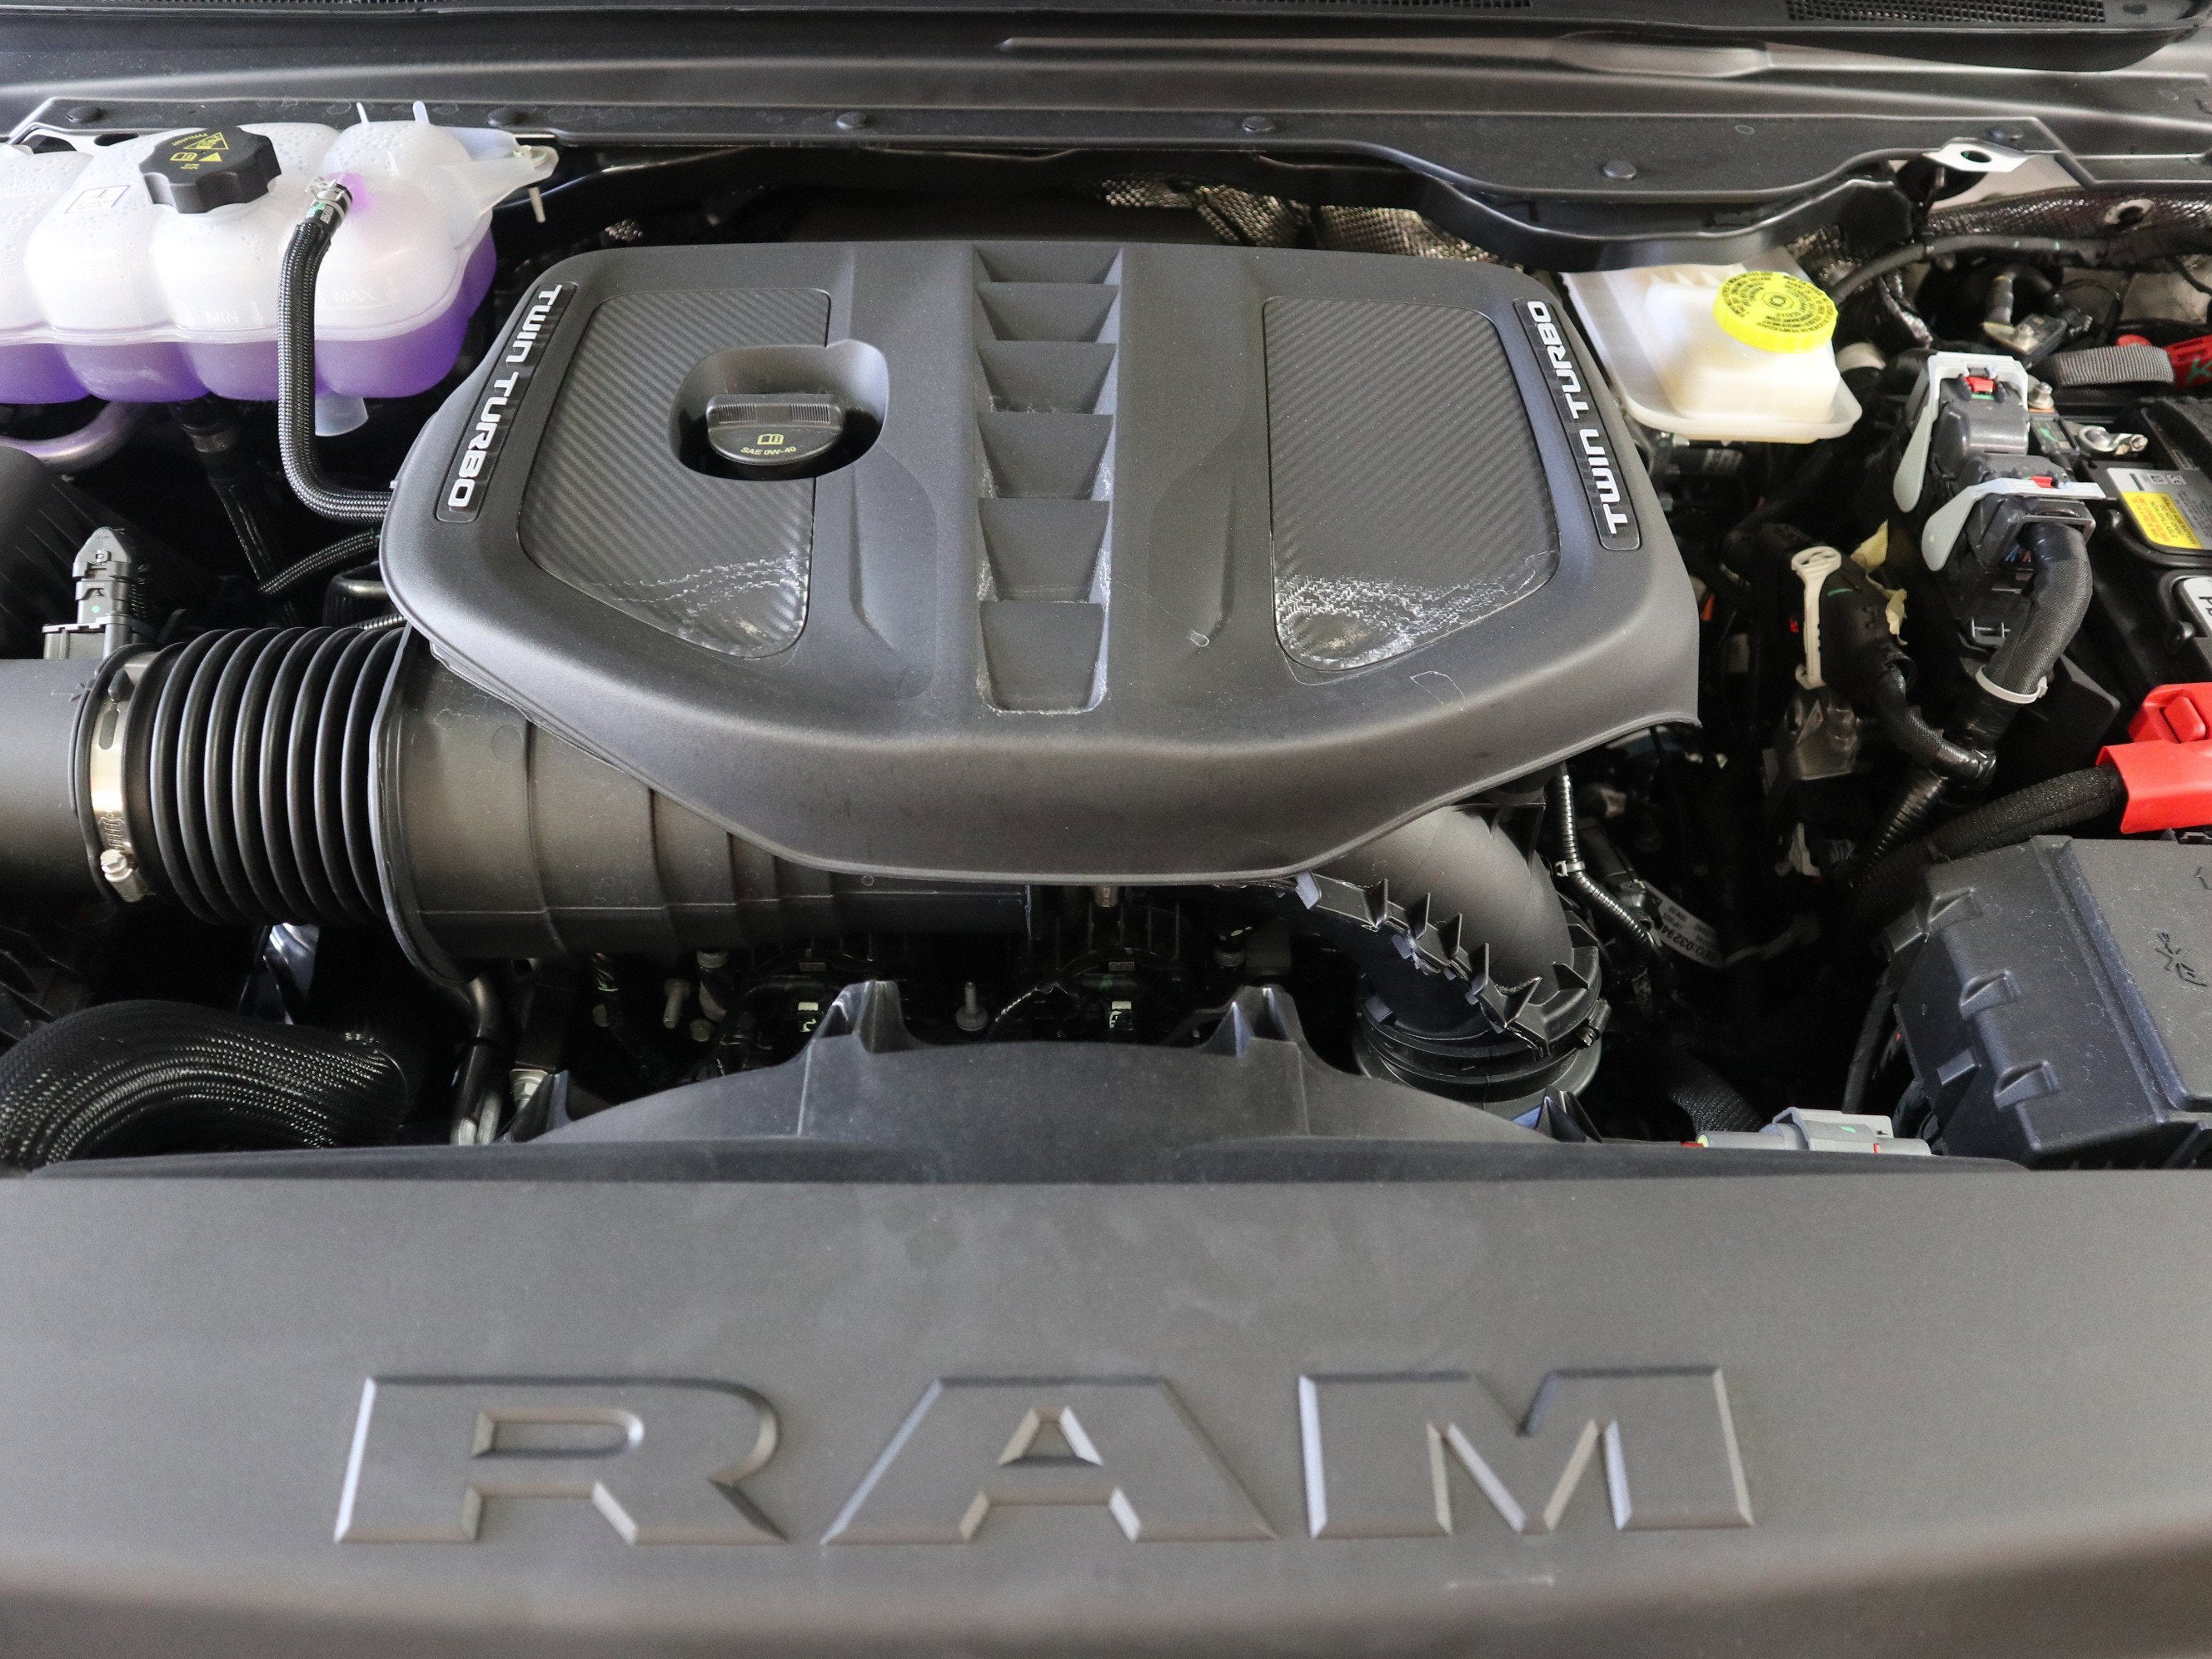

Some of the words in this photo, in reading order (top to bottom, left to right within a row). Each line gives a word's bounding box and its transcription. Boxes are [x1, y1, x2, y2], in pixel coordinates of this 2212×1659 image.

[207, 309, 239, 323] MIN
[334, 289, 375, 303] MAX
[506, 284, 562, 363] TWIN
[1527, 301, 1590, 419] TURBO
[447, 371, 520, 507] TURBO
[740, 446, 763, 456] SAE
[764, 446, 797, 456] 0W-40
[1579, 428, 1628, 535] TWIN
[335, 1366, 1755, 1546] RAM
